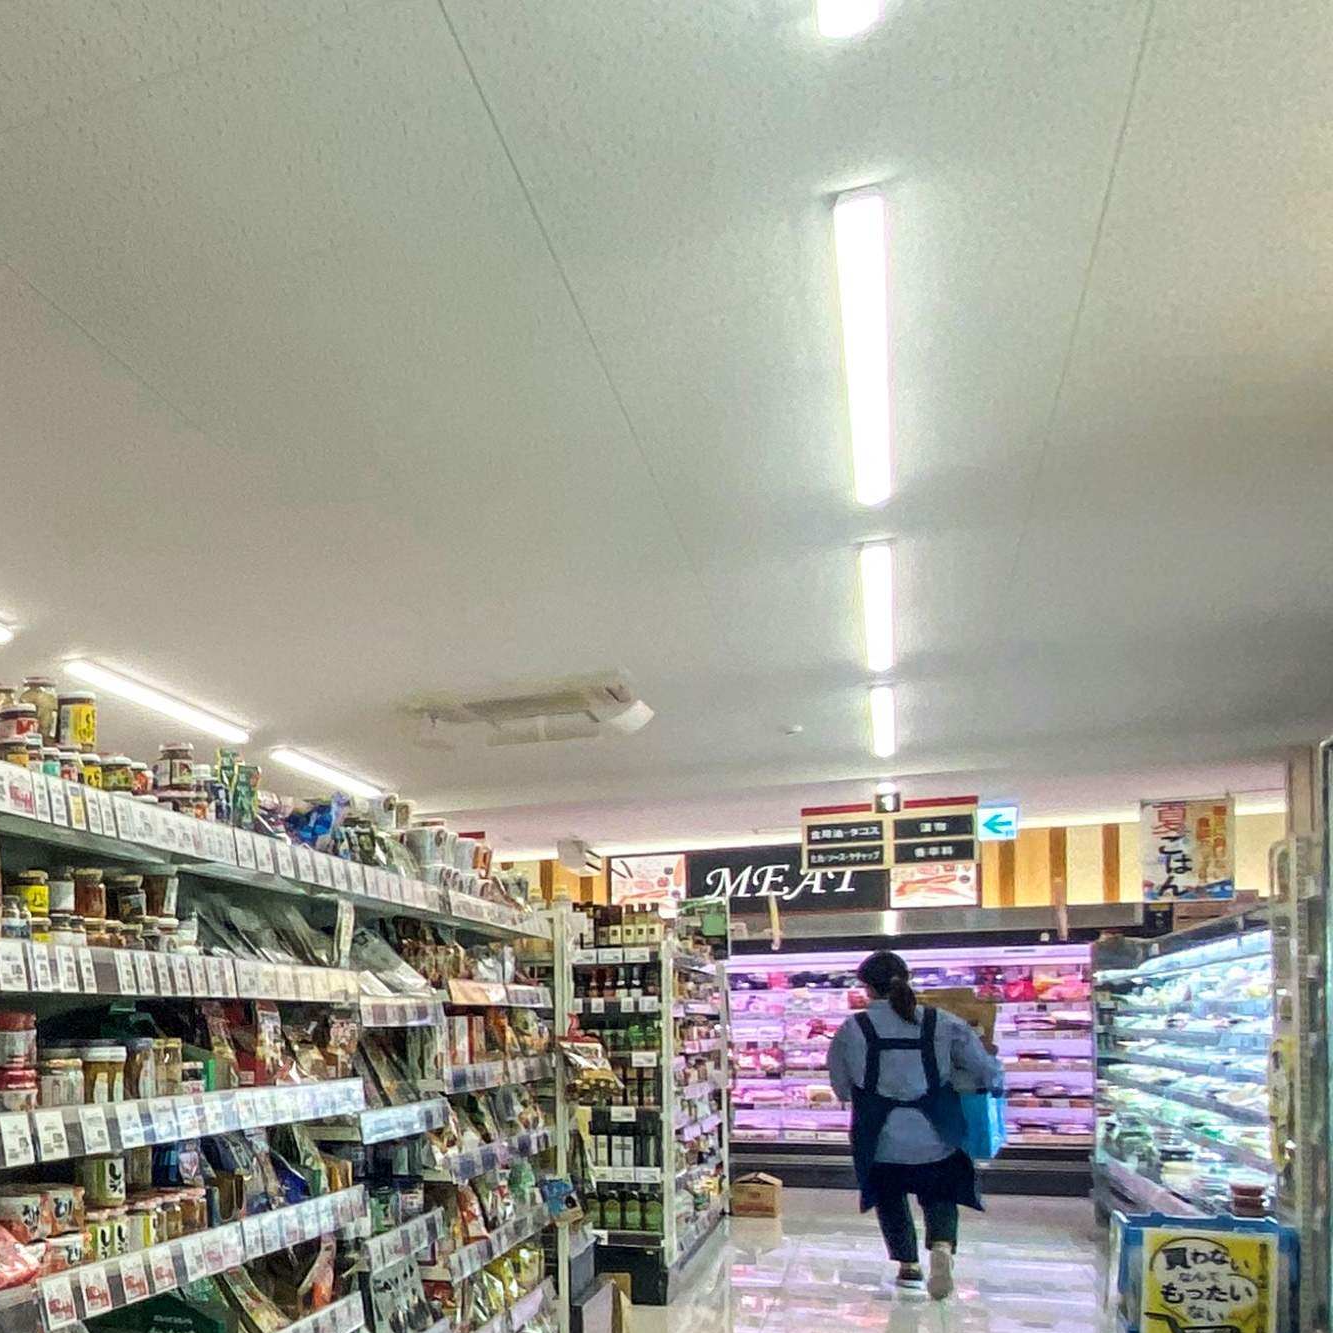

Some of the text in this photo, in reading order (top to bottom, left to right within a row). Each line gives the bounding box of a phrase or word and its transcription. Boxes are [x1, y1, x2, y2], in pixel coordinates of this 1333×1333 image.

[1151, 800, 1192, 897] 夏ごはん
[704, 863, 859, 901] MEAT
[1162, 1247, 1250, 1271] 買わない
[1160, 1282, 1253, 1304] もったい
